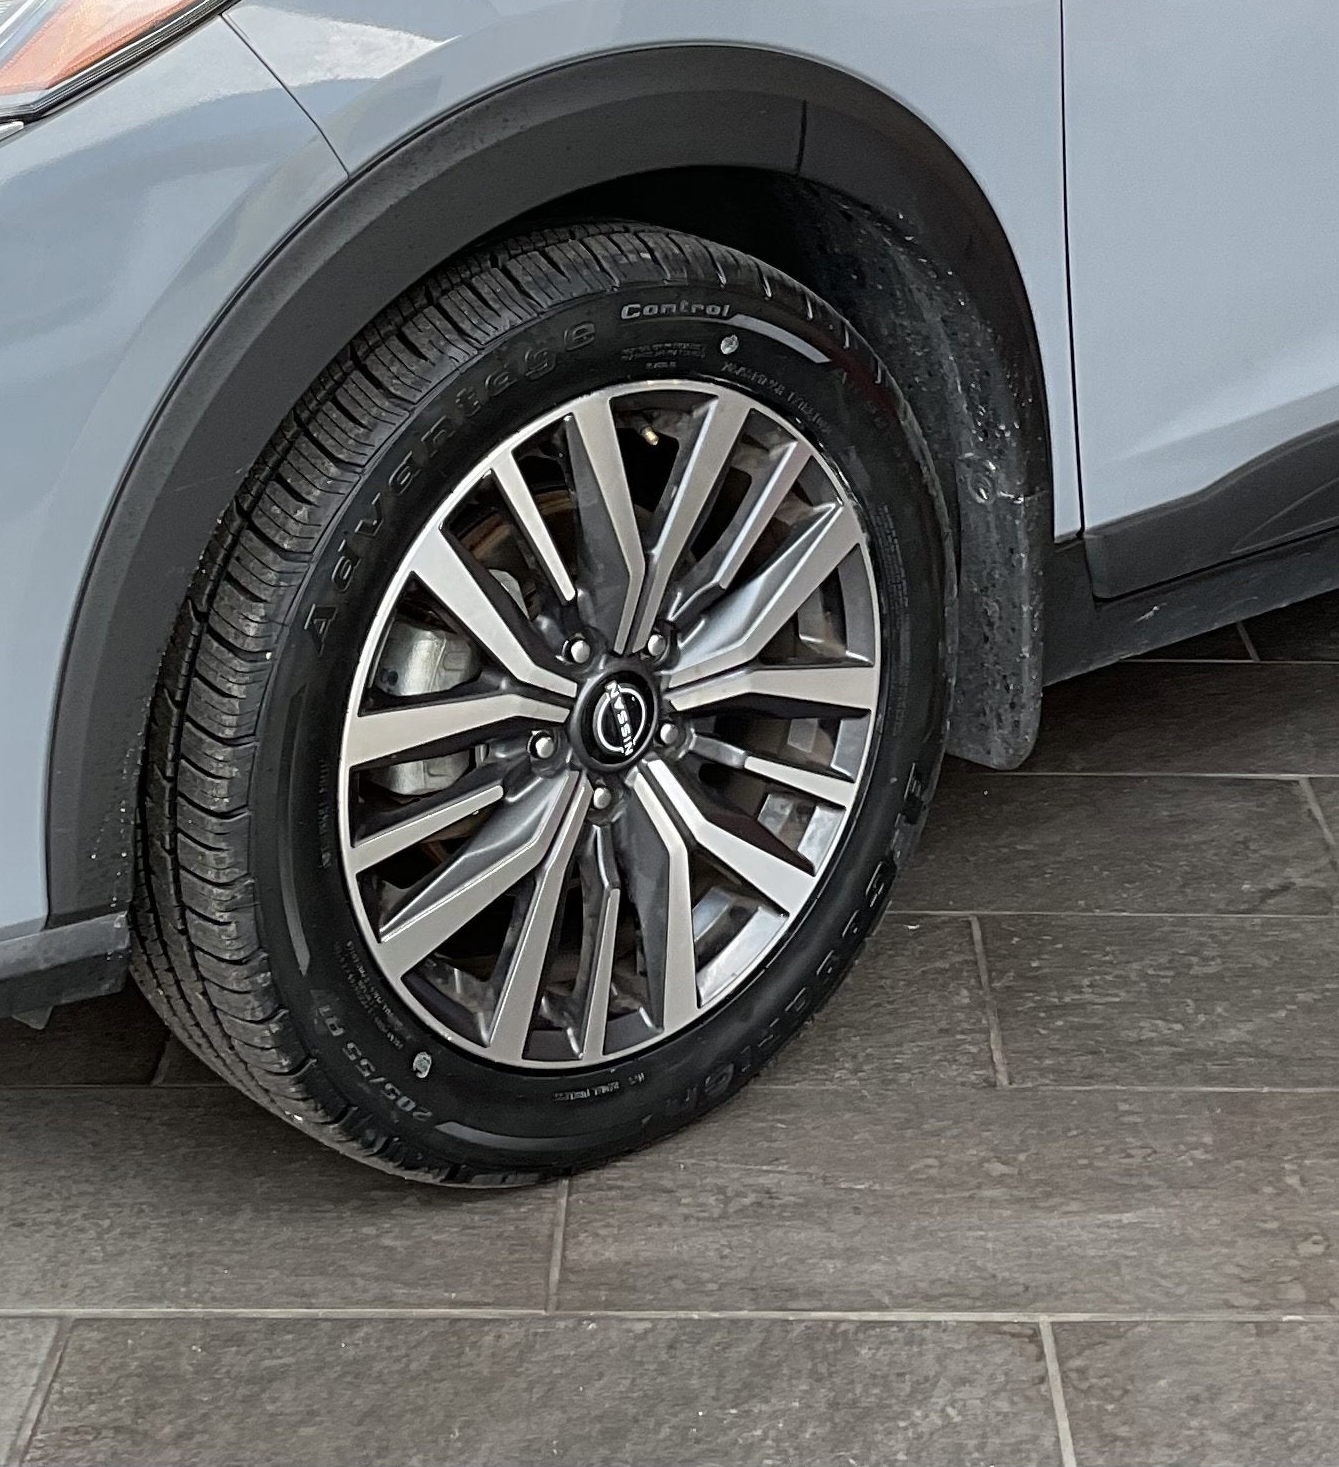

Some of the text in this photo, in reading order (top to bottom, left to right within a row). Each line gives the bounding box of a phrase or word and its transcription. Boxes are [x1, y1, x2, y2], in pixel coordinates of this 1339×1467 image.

[304, 301, 730, 657] Advantage Control
[605, 679, 634, 757] NISSAN
[342, 1042, 433, 1122] 205/55
